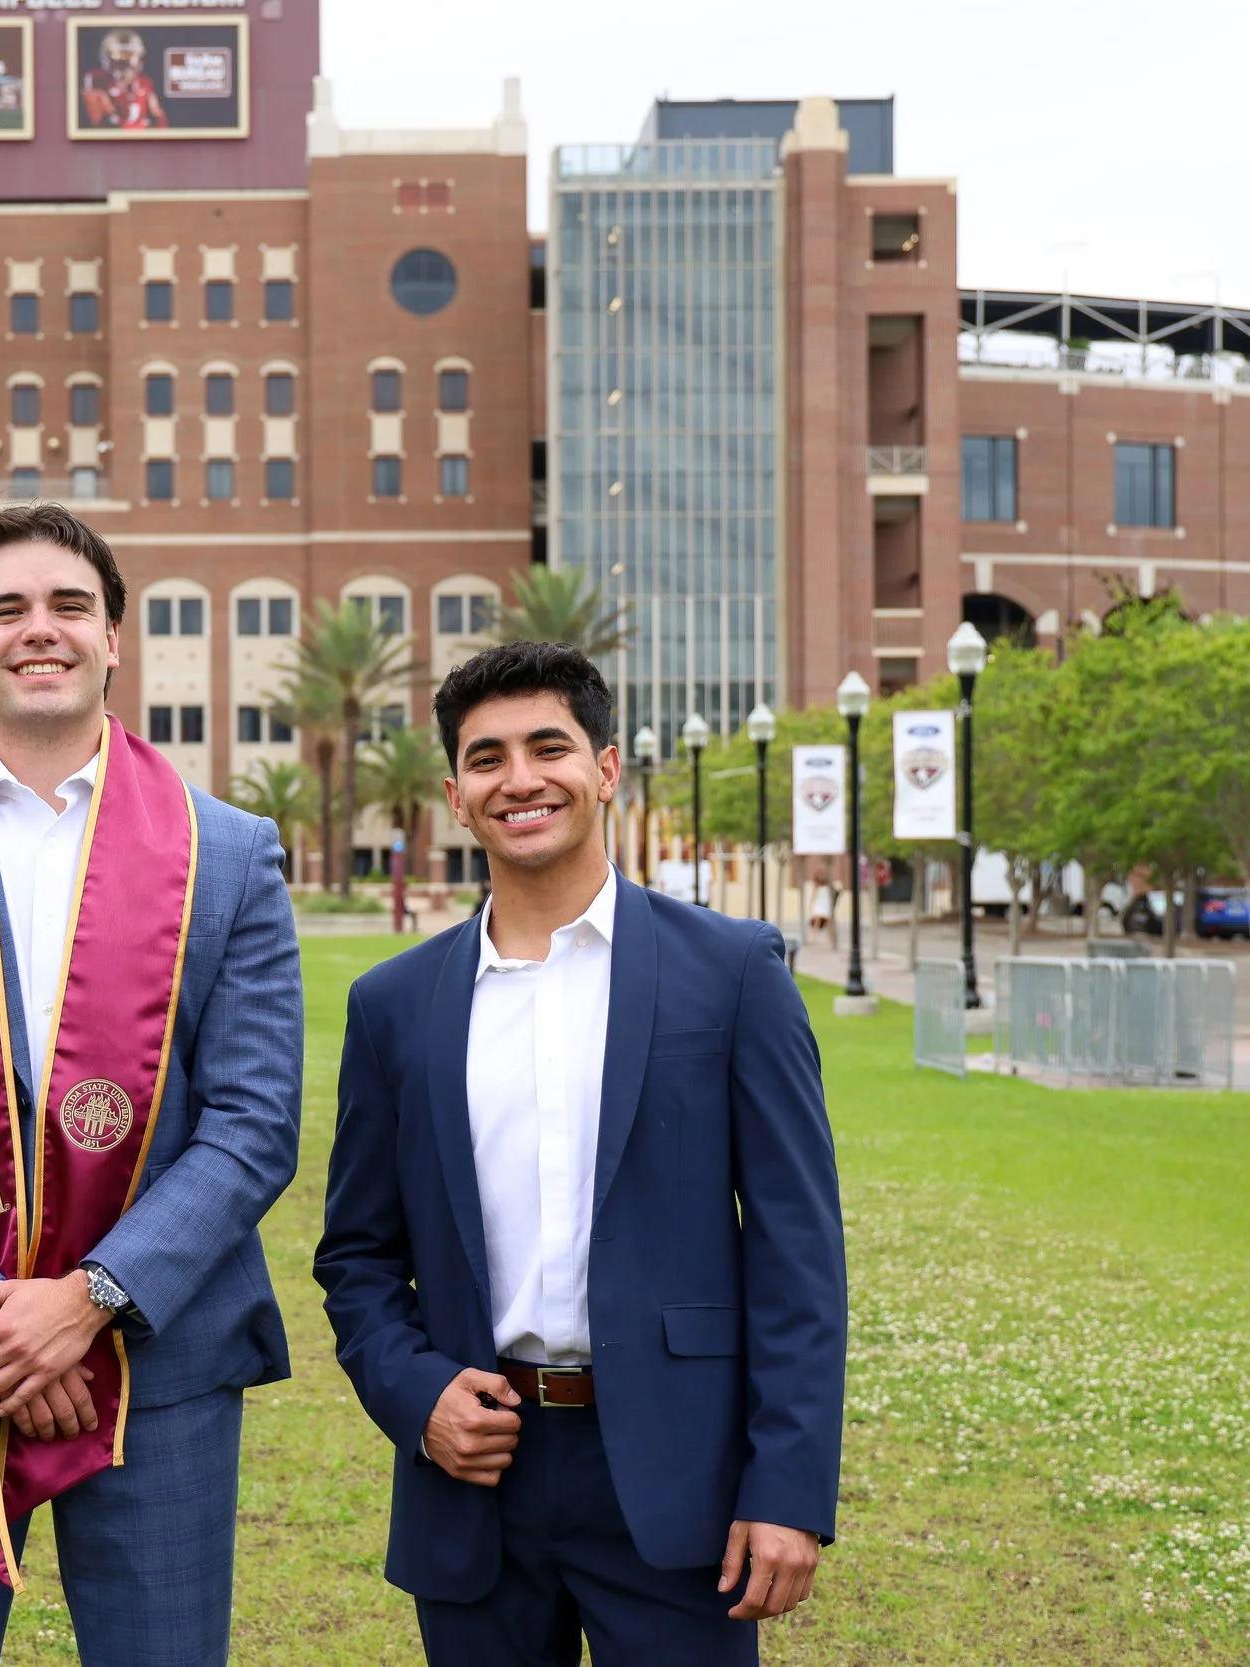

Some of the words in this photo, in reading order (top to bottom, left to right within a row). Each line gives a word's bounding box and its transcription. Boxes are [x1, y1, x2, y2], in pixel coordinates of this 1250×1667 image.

[64, 1090, 82, 1129] FLORIDA
[82, 1083, 109, 1093] STATE
[110, 1088, 129, 1139] UNIVERSITY
[82, 1138, 100, 1148] 1851
